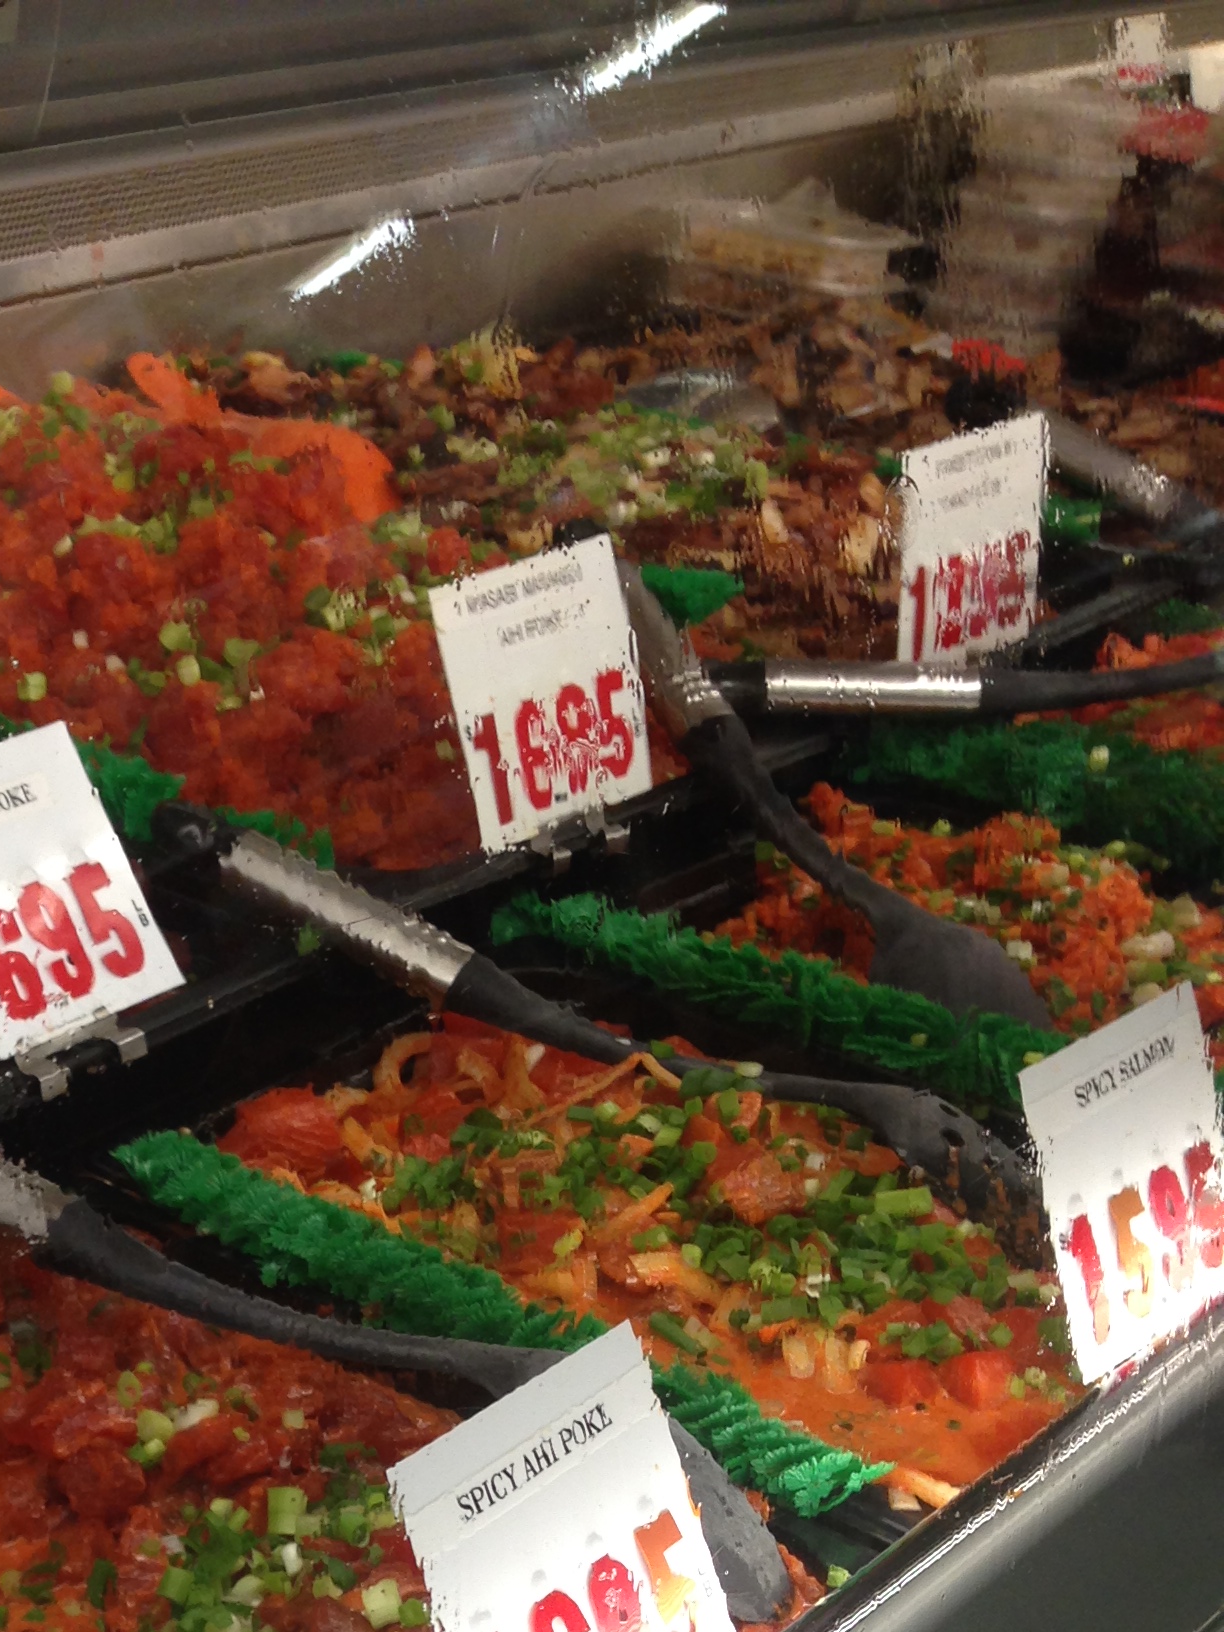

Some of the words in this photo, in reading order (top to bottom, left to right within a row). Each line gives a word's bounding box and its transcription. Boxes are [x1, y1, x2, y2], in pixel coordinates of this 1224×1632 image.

[1074, 1065, 1117, 1109] SPICY
[457, 1463, 519, 1521] SPICY
[523, 1437, 560, 1482] AHI
[558, 1402, 613, 1456] POKE
